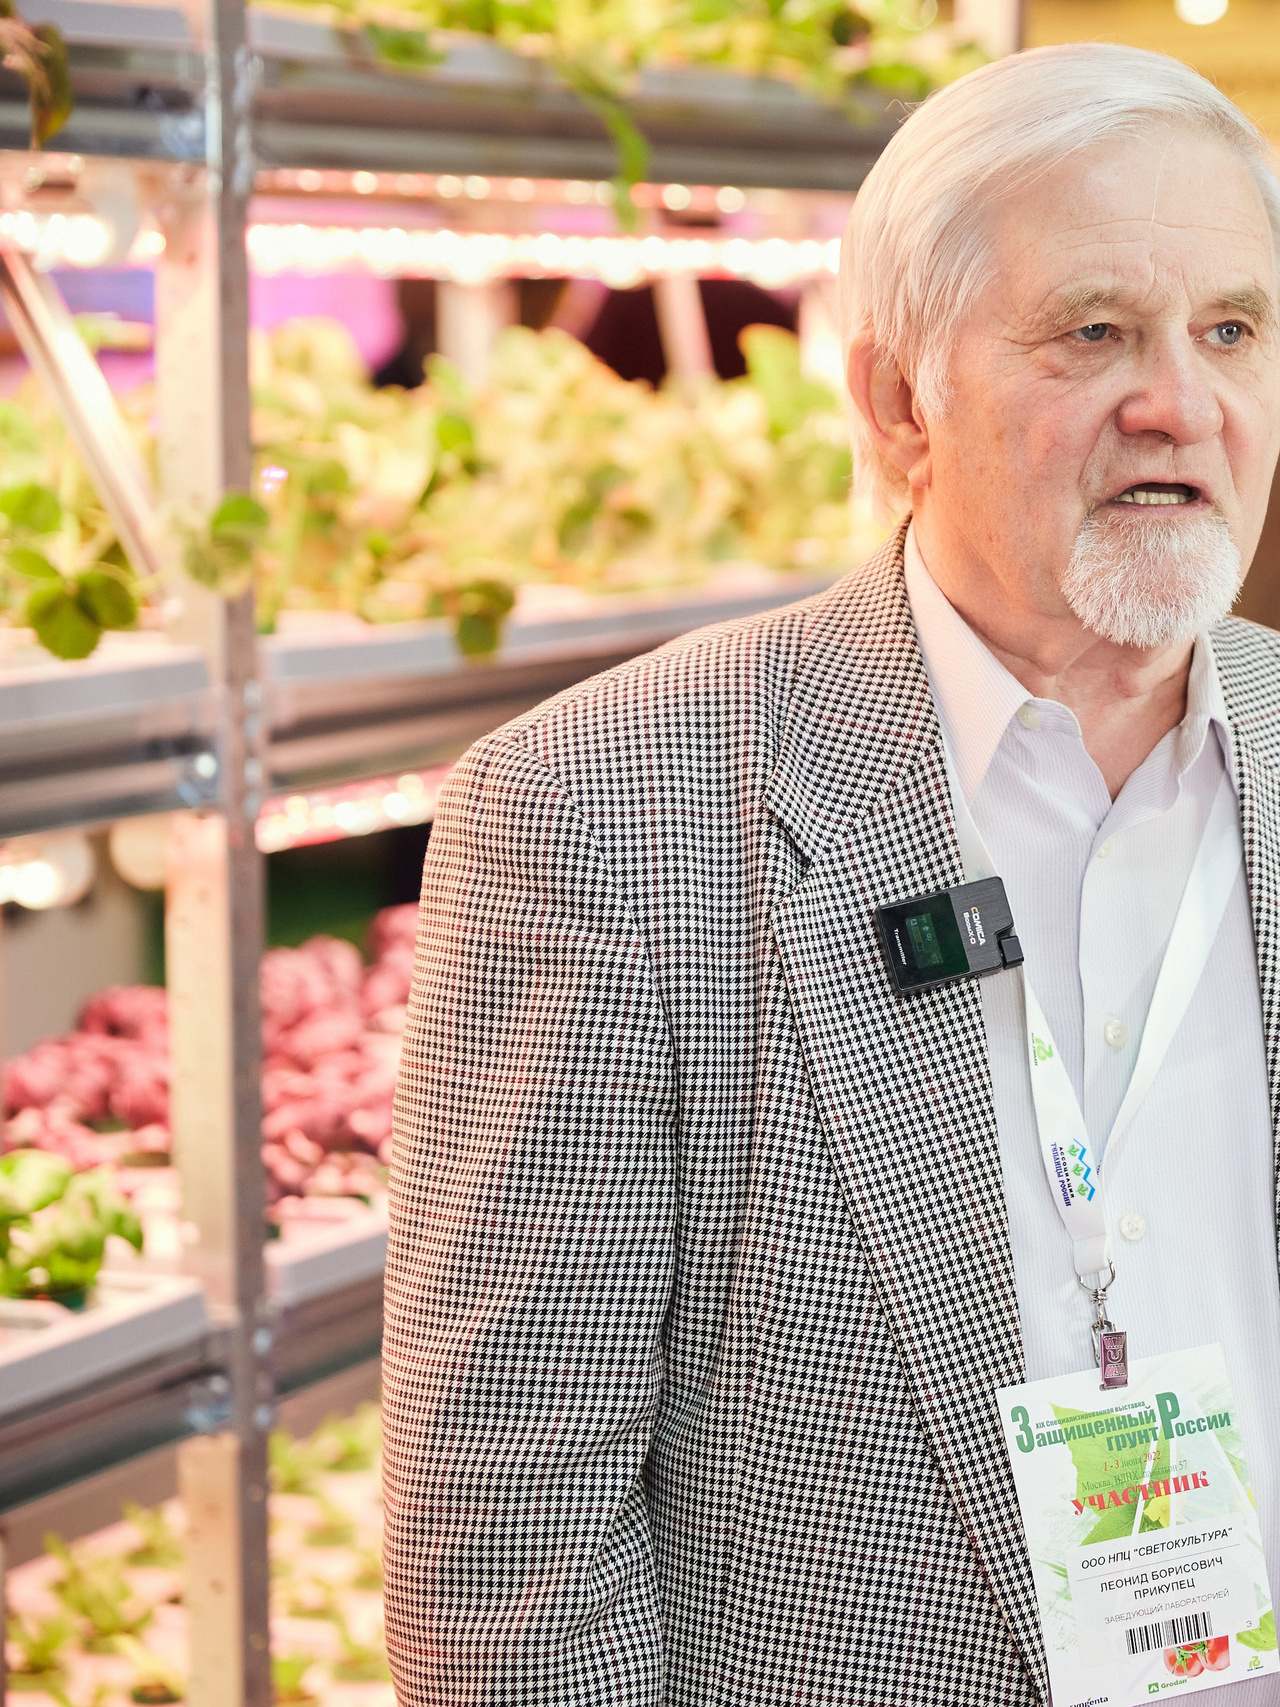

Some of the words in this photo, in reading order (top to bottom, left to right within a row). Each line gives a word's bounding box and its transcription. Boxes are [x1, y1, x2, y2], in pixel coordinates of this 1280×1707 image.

[971, 906, 986, 946] COMICA
[893, 928, 907, 966] Transmitter
[1058, 1146, 1075, 1199] АССОЦИАЦИЯ
[1059, 1178, 1072, 1207] РОССИИ
[1010, 1405, 1157, 1453] Защищенный
[1046, 1407, 1114, 1428] Специализированная
[1114, 1401, 1146, 1412] выставка
[1106, 1426, 1159, 1452] грунт
[1155, 1391, 1231, 1441] России
[1103, 1461, 1108, 1471] 1
[1114, 1459, 1120, 1469] 3
[1143, 1450, 1161, 1463] 2022
[1178, 1459, 1188, 1471] 57
[1070, 1470, 1210, 1516] УЧАСТНИК
[1081, 1556, 1106, 1570] ООО
[1108, 1550, 1131, 1564] НПЦ
[1133, 1527, 1233, 1557] "СВЕТОКУЛЬТУРА"
[1100, 1573, 1149, 1593] ЛЕОНИД
[1151, 1556, 1224, 1581] БОРИСОВИЧ
[1134, 1577, 1196, 1600] ПРИКУПЕЦ
[1104, 1603, 1164, 1624] ЗАВЕДУЮЩИЙ
[1164, 1588, 1230, 1611] ЛАБОРАТОРИЕЙ
[1160, 1678, 1188, 1689] Grodan
